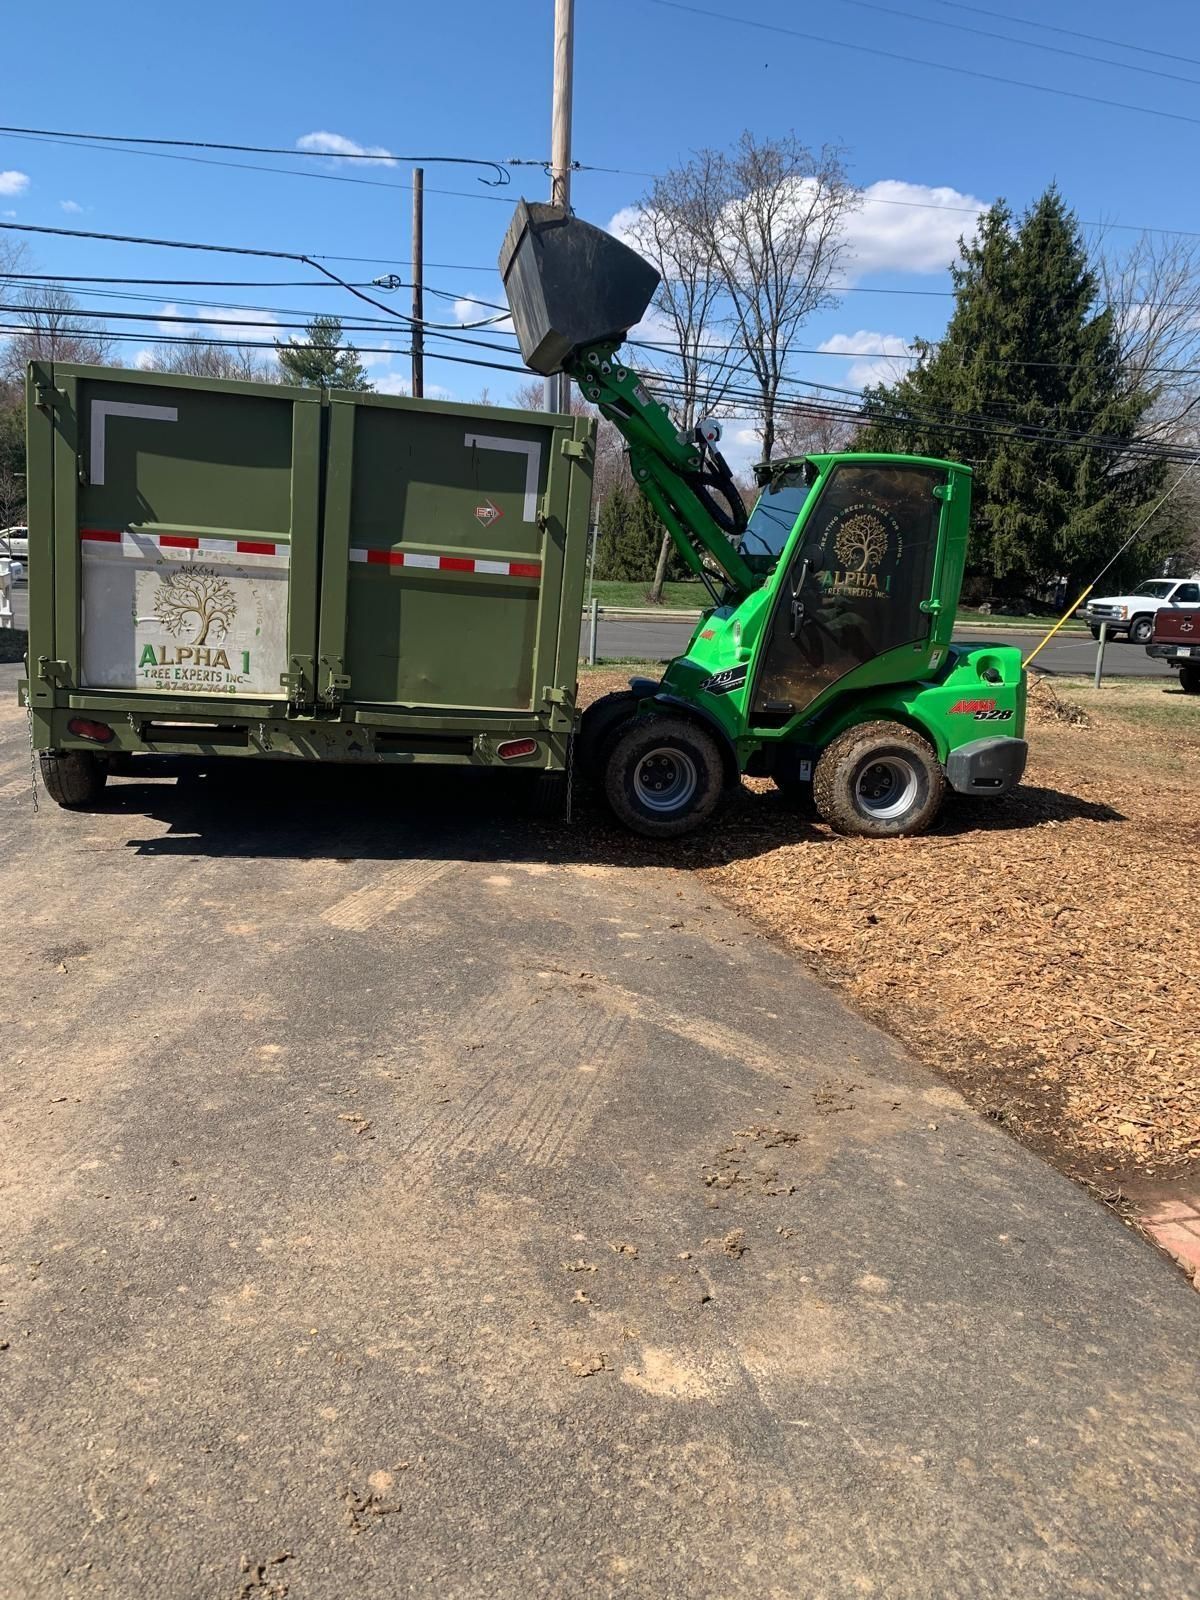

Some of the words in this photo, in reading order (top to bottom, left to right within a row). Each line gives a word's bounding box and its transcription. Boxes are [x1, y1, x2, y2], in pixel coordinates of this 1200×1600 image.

[820, 515, 839, 550] REATING
[822, 570, 878, 588] ALPHA
[843, 588, 873, 598] EXPERTS
[252, 590, 264, 625] LIVING
[139, 644, 230, 670] ALPHA
[143, 669, 170, 680] TREE
[174, 668, 222, 682] EXPERTS
[226, 672, 244, 684] INC
[973, 709, 1013, 721] 528
